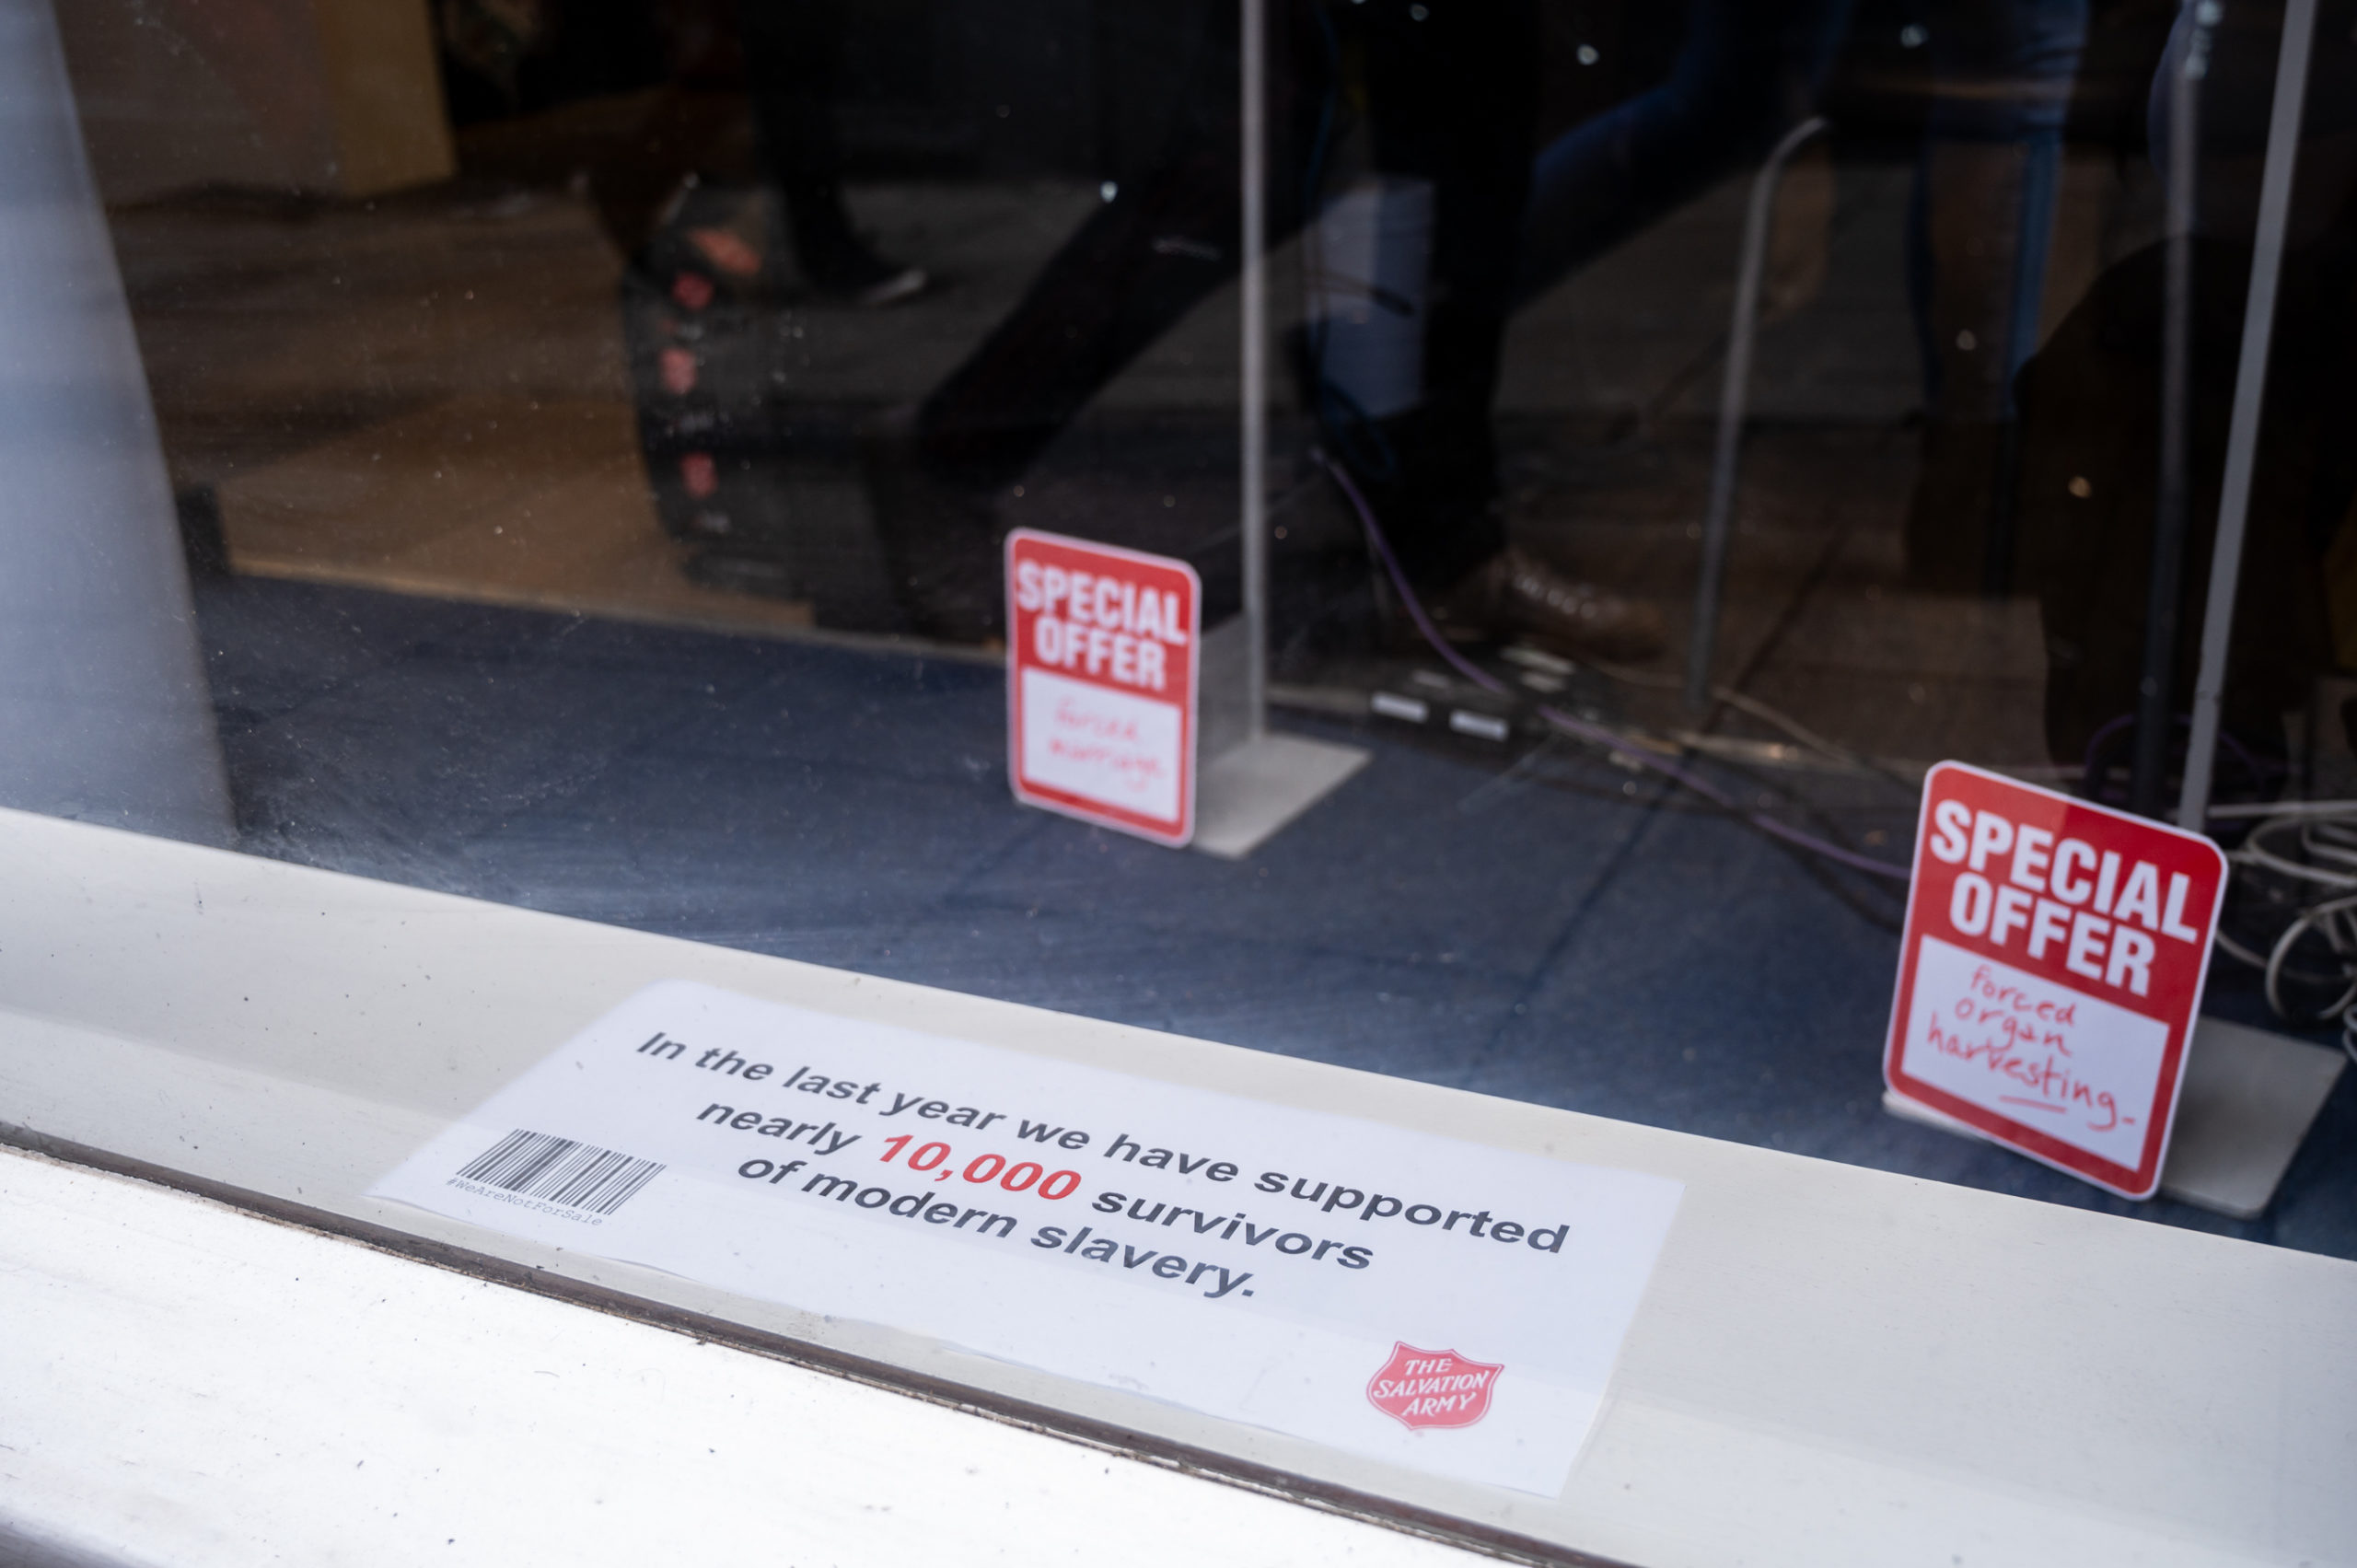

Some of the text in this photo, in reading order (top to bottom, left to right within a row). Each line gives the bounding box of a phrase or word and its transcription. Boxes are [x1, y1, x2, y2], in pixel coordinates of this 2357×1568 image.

[1016, 559, 1188, 645] SPECIAL
[1034, 616, 1167, 691] OFFER
[1930, 799, 2198, 945] SPECIAL
[1949, 872, 2156, 998] OFFER
[1956, 998, 2072, 1058] organ
[1971, 963, 2074, 1028] forced
[636, 1031, 1570, 1255] In the last year we have supported
[446, 1177, 604, 1226] #WeAreNotForSale
[696, 1101, 1375, 1272] nearly 10,000 survivors
[737, 1156, 1254, 1299] of modern slavery.
[1373, 1369, 1490, 1398] SALVATION
[1401, 1391, 1477, 1417] ARMY
[1405, 1358, 1453, 1376] THE
